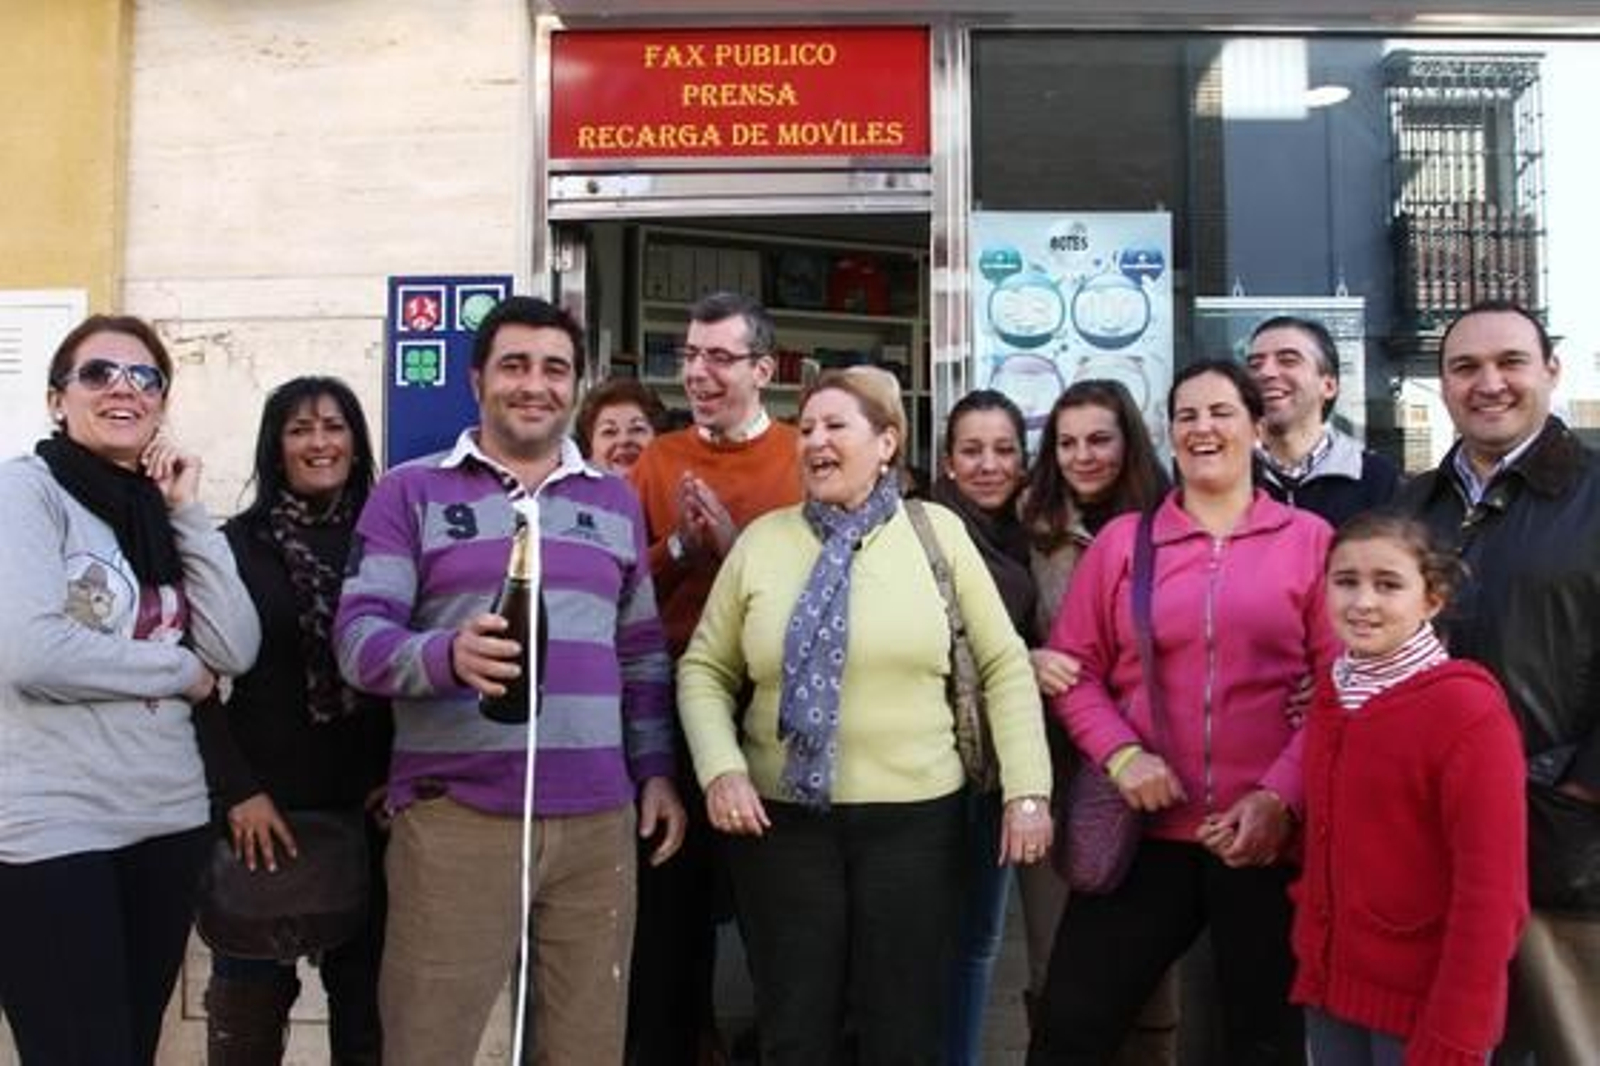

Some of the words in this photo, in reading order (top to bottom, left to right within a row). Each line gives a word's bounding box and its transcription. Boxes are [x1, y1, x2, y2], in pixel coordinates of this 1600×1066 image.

[643, 44, 706, 68] FAX
[714, 43, 837, 67] PUBLICO
[682, 83, 799, 106] PRENSA
[577, 124, 722, 149] RECARGA
[731, 123, 769, 146] DE
[777, 119, 904, 146] MOVILES
[444, 503, 478, 539] 9
